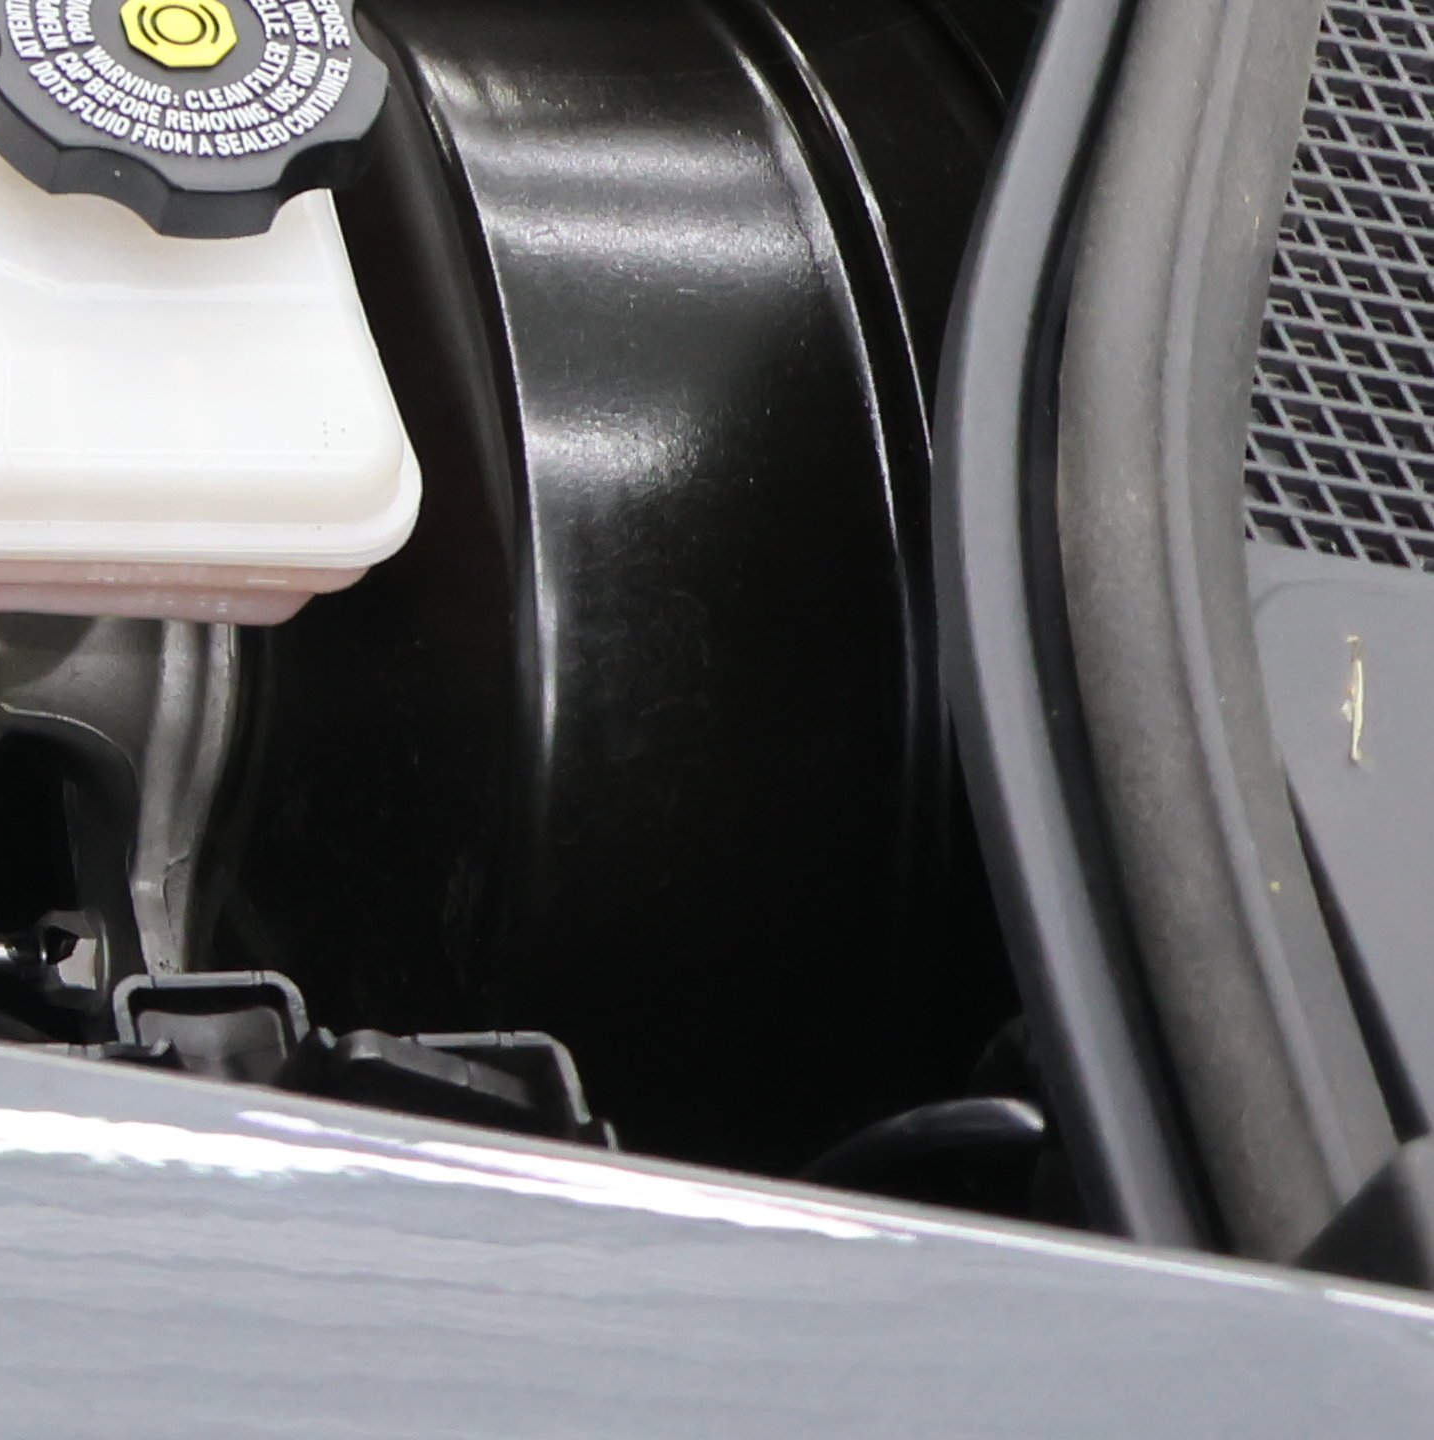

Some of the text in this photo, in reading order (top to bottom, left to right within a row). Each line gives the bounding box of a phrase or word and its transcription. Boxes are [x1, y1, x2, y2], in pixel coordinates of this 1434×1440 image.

[285, 0, 321, 44] DOT3
[29, 57, 352, 157] DOT3 FLUID FROM A SEALED CONTAINER.
[55, 45, 321, 133] CAP BEFORE REMOVING. USE ONLY
[82, 41, 291, 111] WARNING: CLEAN FILLER
